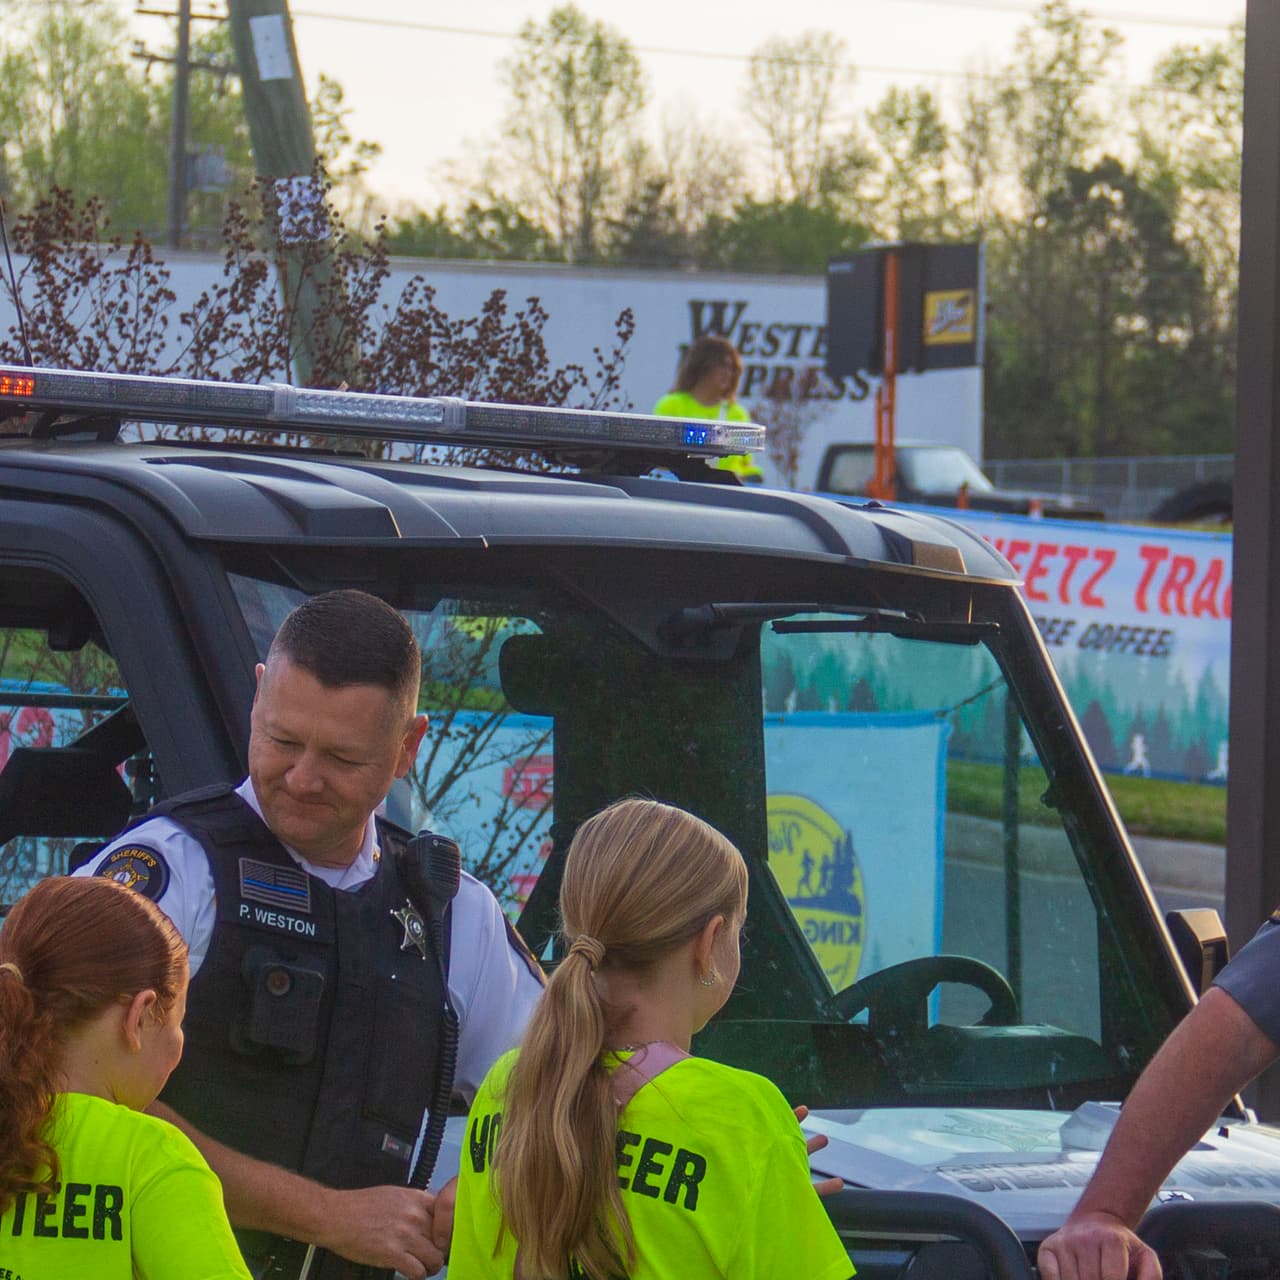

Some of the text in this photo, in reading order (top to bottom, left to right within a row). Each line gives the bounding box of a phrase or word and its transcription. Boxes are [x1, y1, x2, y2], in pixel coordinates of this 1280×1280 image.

[688, 300, 830, 358] WESTE
[1134, 545, 1233, 620] TRA
[111, 848, 158, 867] SHERIFF'S
[239, 904, 316, 936] P. WESTON
